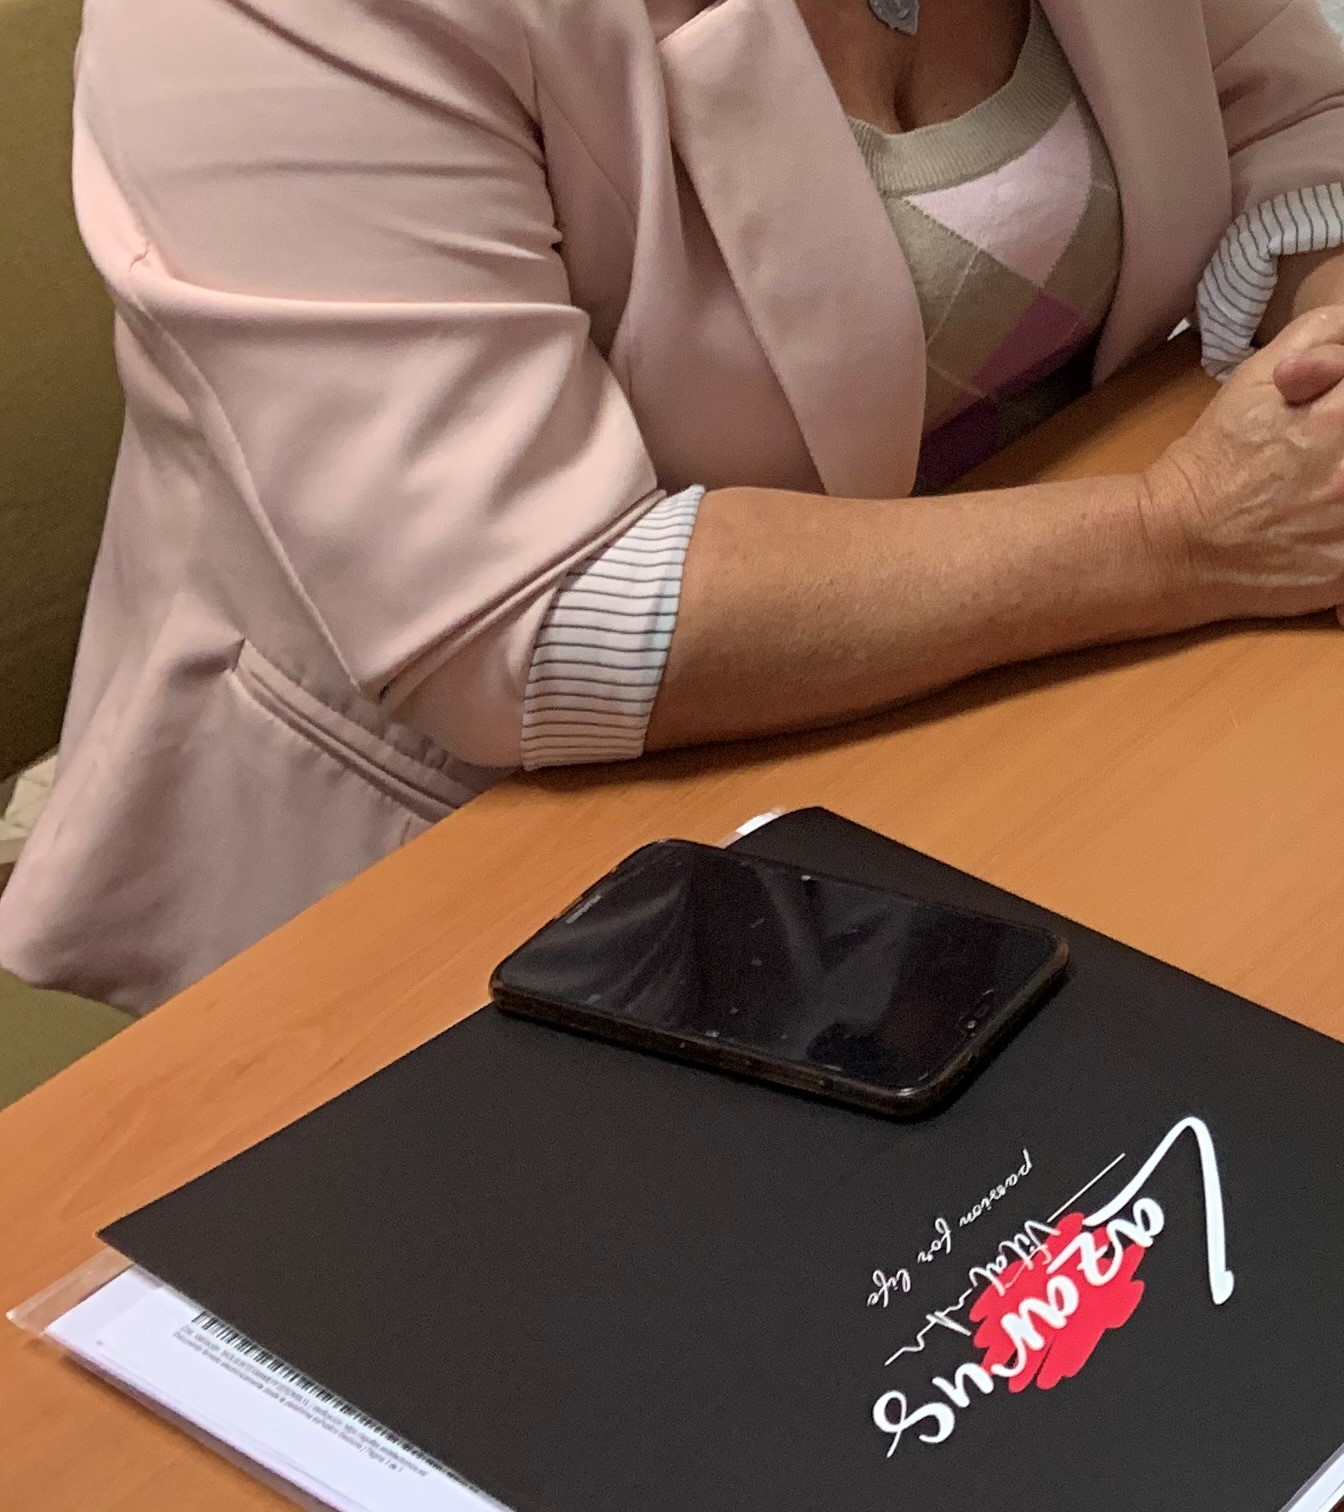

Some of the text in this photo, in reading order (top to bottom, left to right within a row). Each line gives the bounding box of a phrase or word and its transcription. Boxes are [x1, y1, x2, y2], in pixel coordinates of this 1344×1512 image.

[866, 1268, 912, 1308] life
[872, 1116, 1235, 1458] Lazarus
[969, 1219, 1062, 1298] Vital
